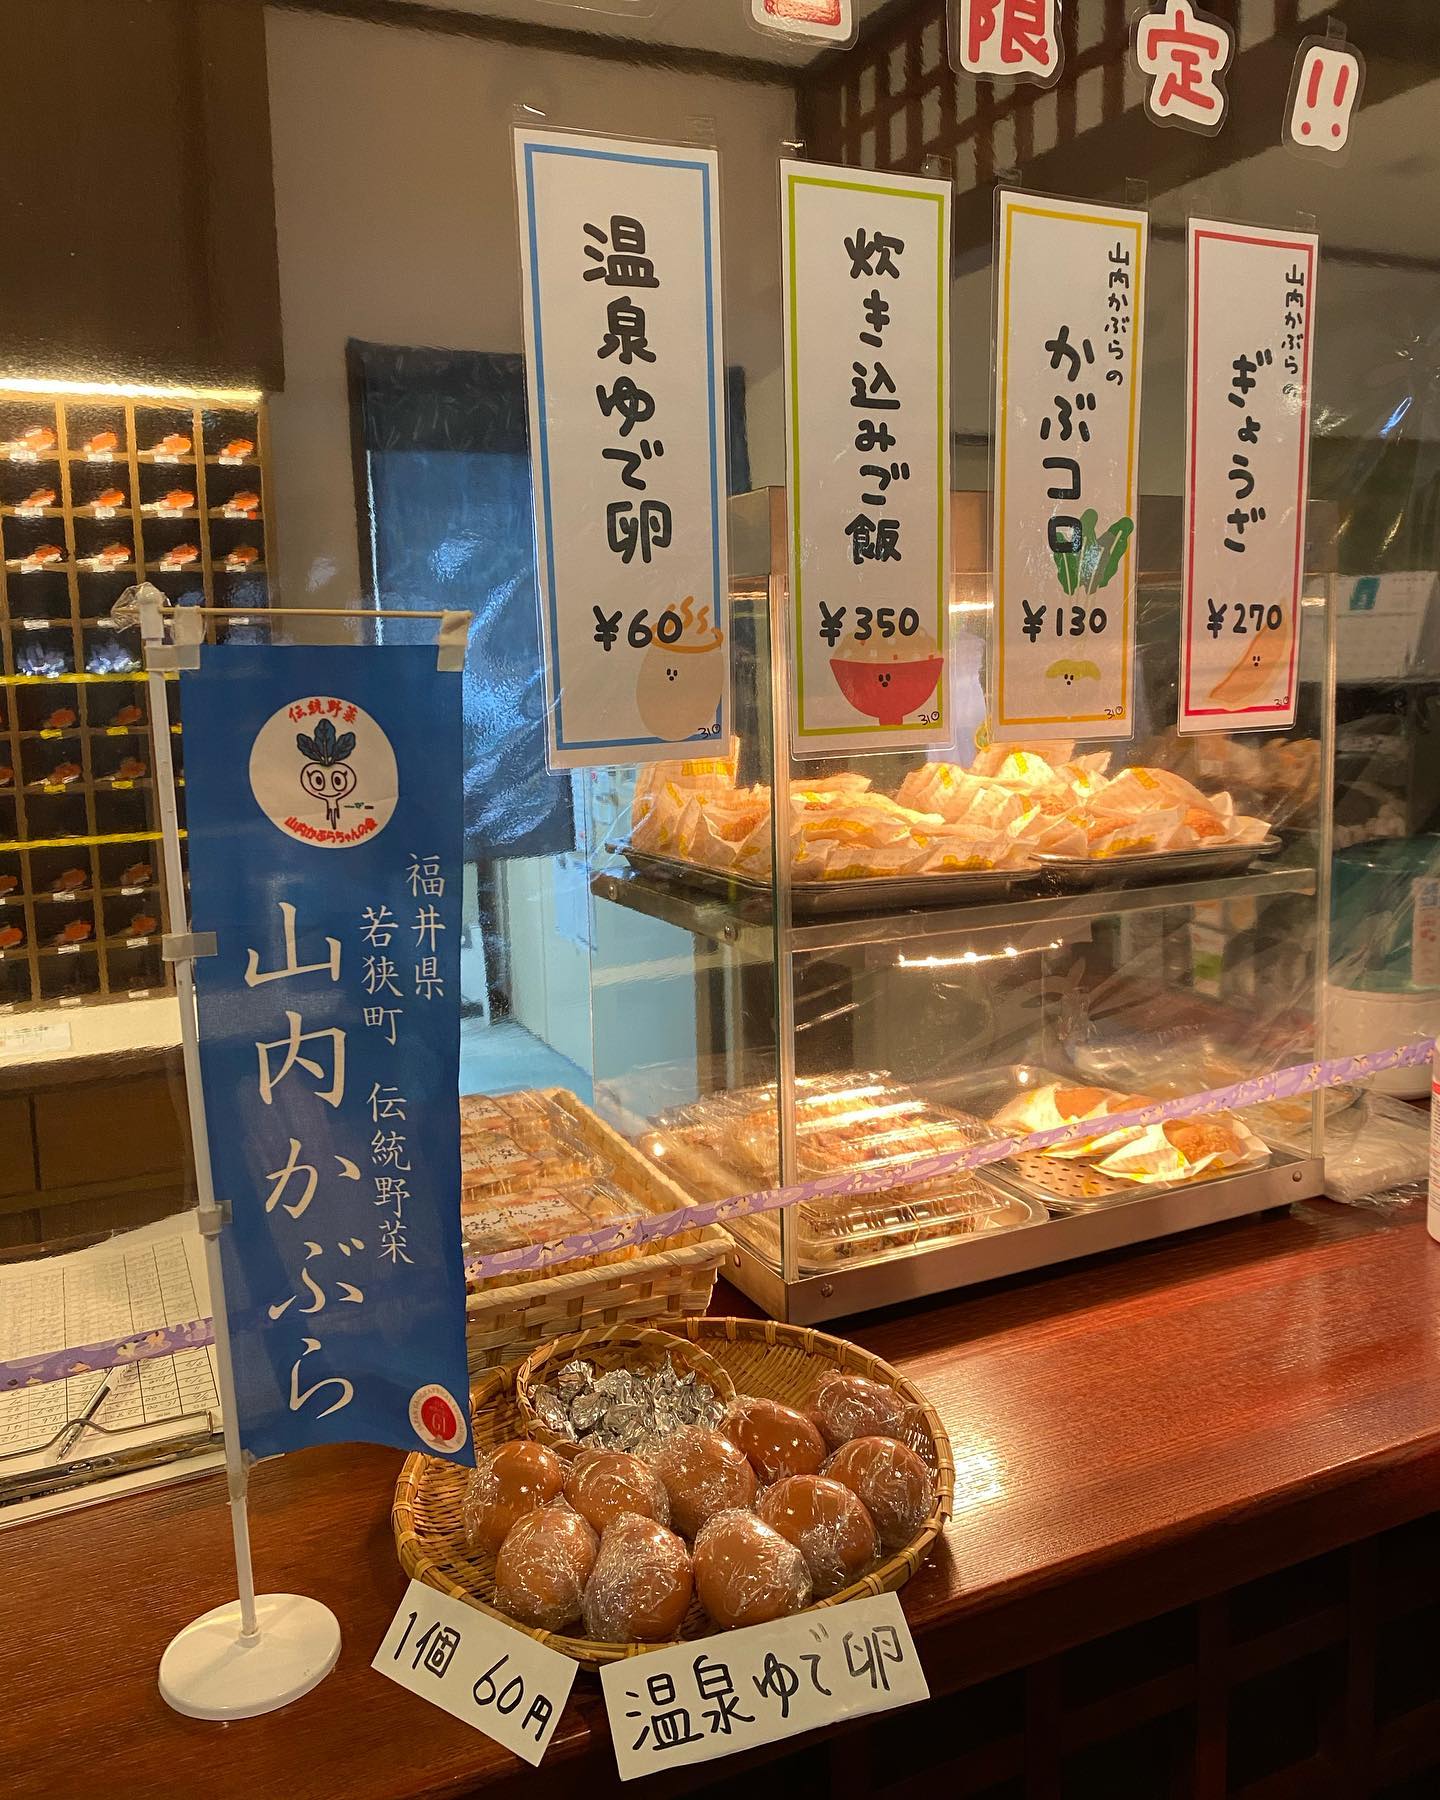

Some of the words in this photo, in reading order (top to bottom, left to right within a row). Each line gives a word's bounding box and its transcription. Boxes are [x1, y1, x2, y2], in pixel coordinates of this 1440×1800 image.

[1104, 242, 1130, 386] 山内かぶらの
[583, 215, 673, 565] 温泉ゆで卵
[844, 227, 911, 566] 炊き込みご飯
[1040, 325, 1097, 554] かぶコロ
[1224, 348, 1273, 553] ぎょうざ
[592, 605, 684, 652] ¥60
[819, 600, 920, 648] ¥350
[1021, 600, 1107, 642] ¥130
[1206, 599, 1283, 639] ¥270
[288, 699, 358, 724] 伝統野菜
[360, 905, 404, 1046] 若狭町
[407, 853, 446, 1000] 福井県
[245, 902, 365, 1421] 山内かぶら
[366, 1082, 415, 1265] 伝統野菜
[394, 1611, 461, 1679] 1個
[472, 1654, 554, 1741] 60円
[625, 1621, 905, 1752] 温泉ゆで卵
